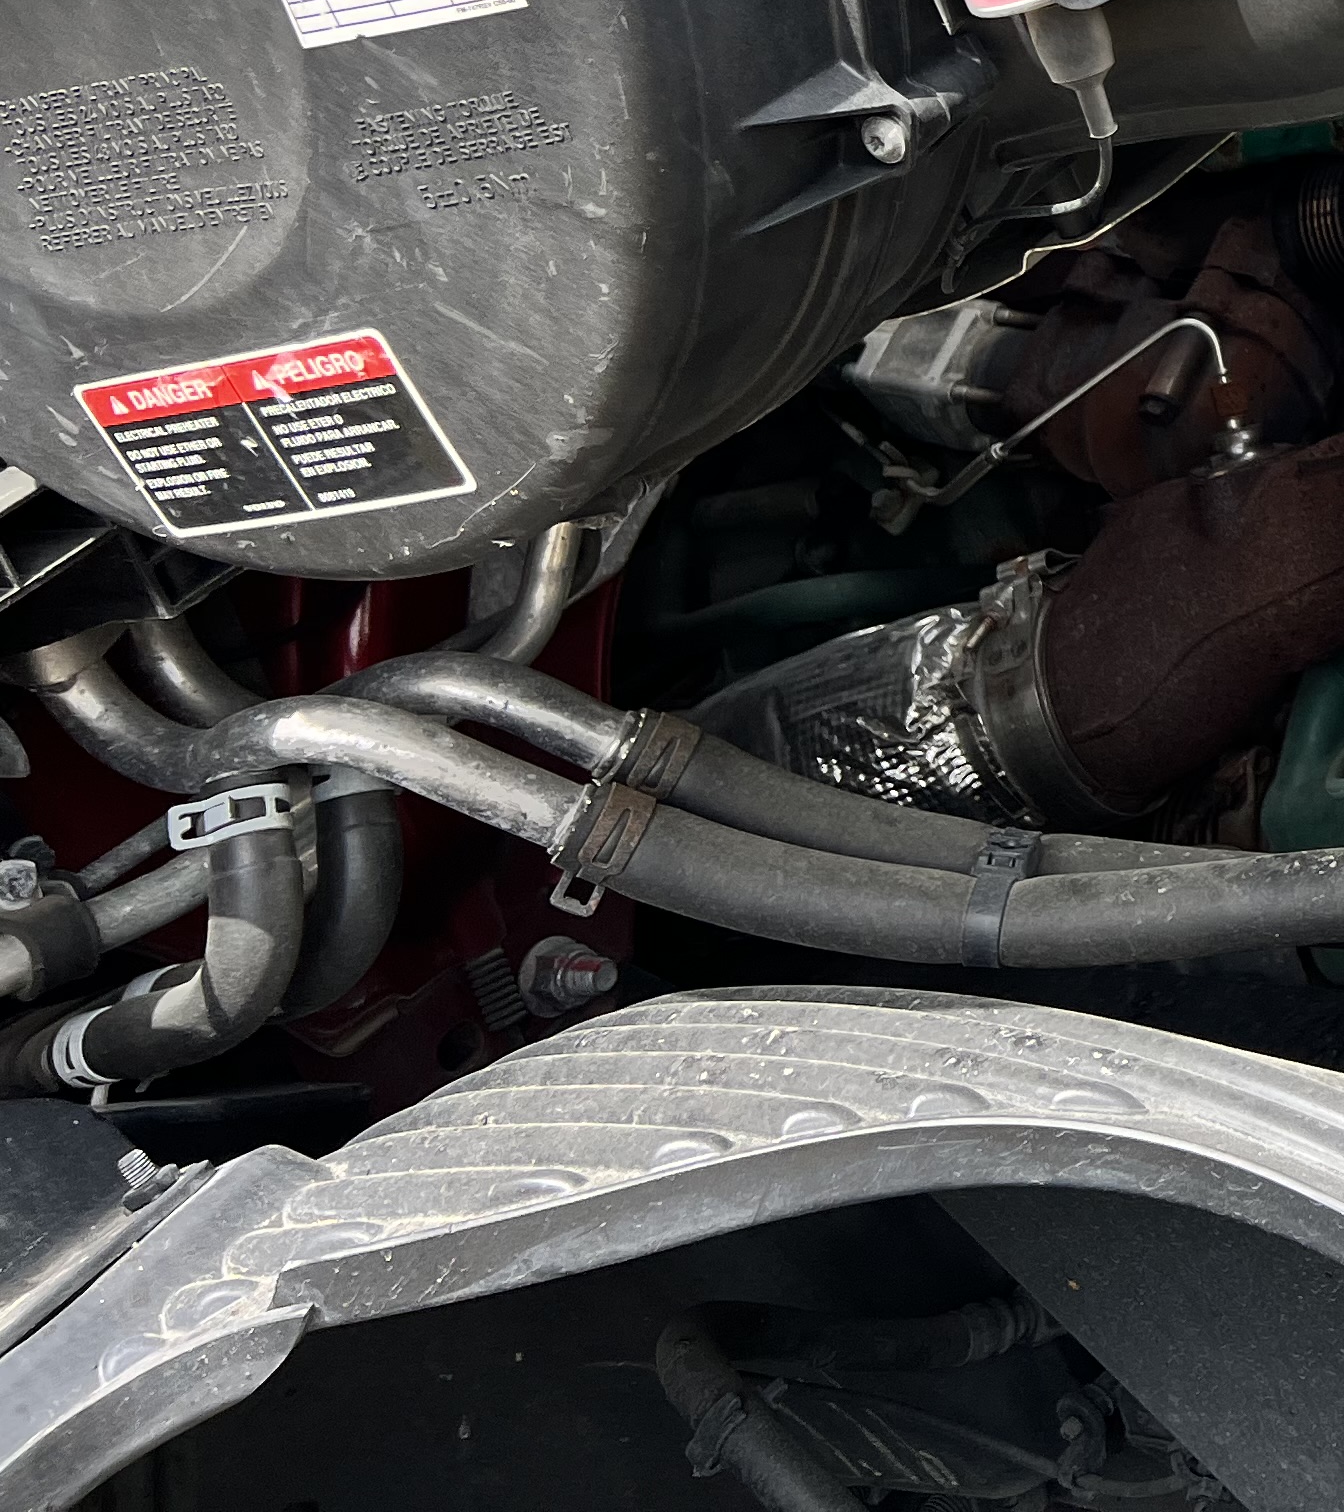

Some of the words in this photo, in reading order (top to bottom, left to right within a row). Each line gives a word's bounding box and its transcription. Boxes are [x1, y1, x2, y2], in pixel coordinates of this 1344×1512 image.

[355, 105, 446, 133] FASTENING
[446, 91, 520, 118] TORQUE
[352, 130, 420, 156] TORQUE
[418, 127, 446, 148] DE
[447, 113, 518, 141] APRIETE
[517, 107, 545, 128] DE
[369, 150, 432, 176] COUPLE
[433, 146, 458, 166] DE
[459, 131, 538, 162] SERRAGE
[538, 122, 573, 147] EST
[272, 350, 365, 384] PELIGRO
[128, 380, 213, 411] DANGER
[260, 394, 341, 417] PRECALENTADOR
[342, 382, 396, 403] ELECTRICO
[114, 424, 166, 443] ELECTRICAL
[165, 416, 220, 435] PREHEATER
[271, 423, 289, 436] NO
[289, 419, 308, 433] USE
[307, 414, 335, 430] ETER
[335, 413, 344, 426] O
[280, 433, 317, 449] FLUIDO
[316, 428, 343, 443] PARA
[342, 418, 401, 439] ARRANCAR.
[126, 450, 139, 461] DO
[140, 446, 159, 459] NOT
[159, 443, 178, 456] USE
[178, 439, 207, 454] ETHER
[206, 436, 222, 448] OR
[290, 449, 327, 465] PUEDE
[326, 441, 376, 459] RESULTAR
[134, 459, 176, 474] STARTING
[146, 473, 192, 489] EXPLOSION
[193, 471, 207, 481] OR
[207, 467, 231, 480] FIRE
[299, 466, 315, 478] EN
[315, 457, 373, 475] EXPLOSION.
[155, 490, 174, 501] MAY
[173, 485, 212, 500] RESULT.
